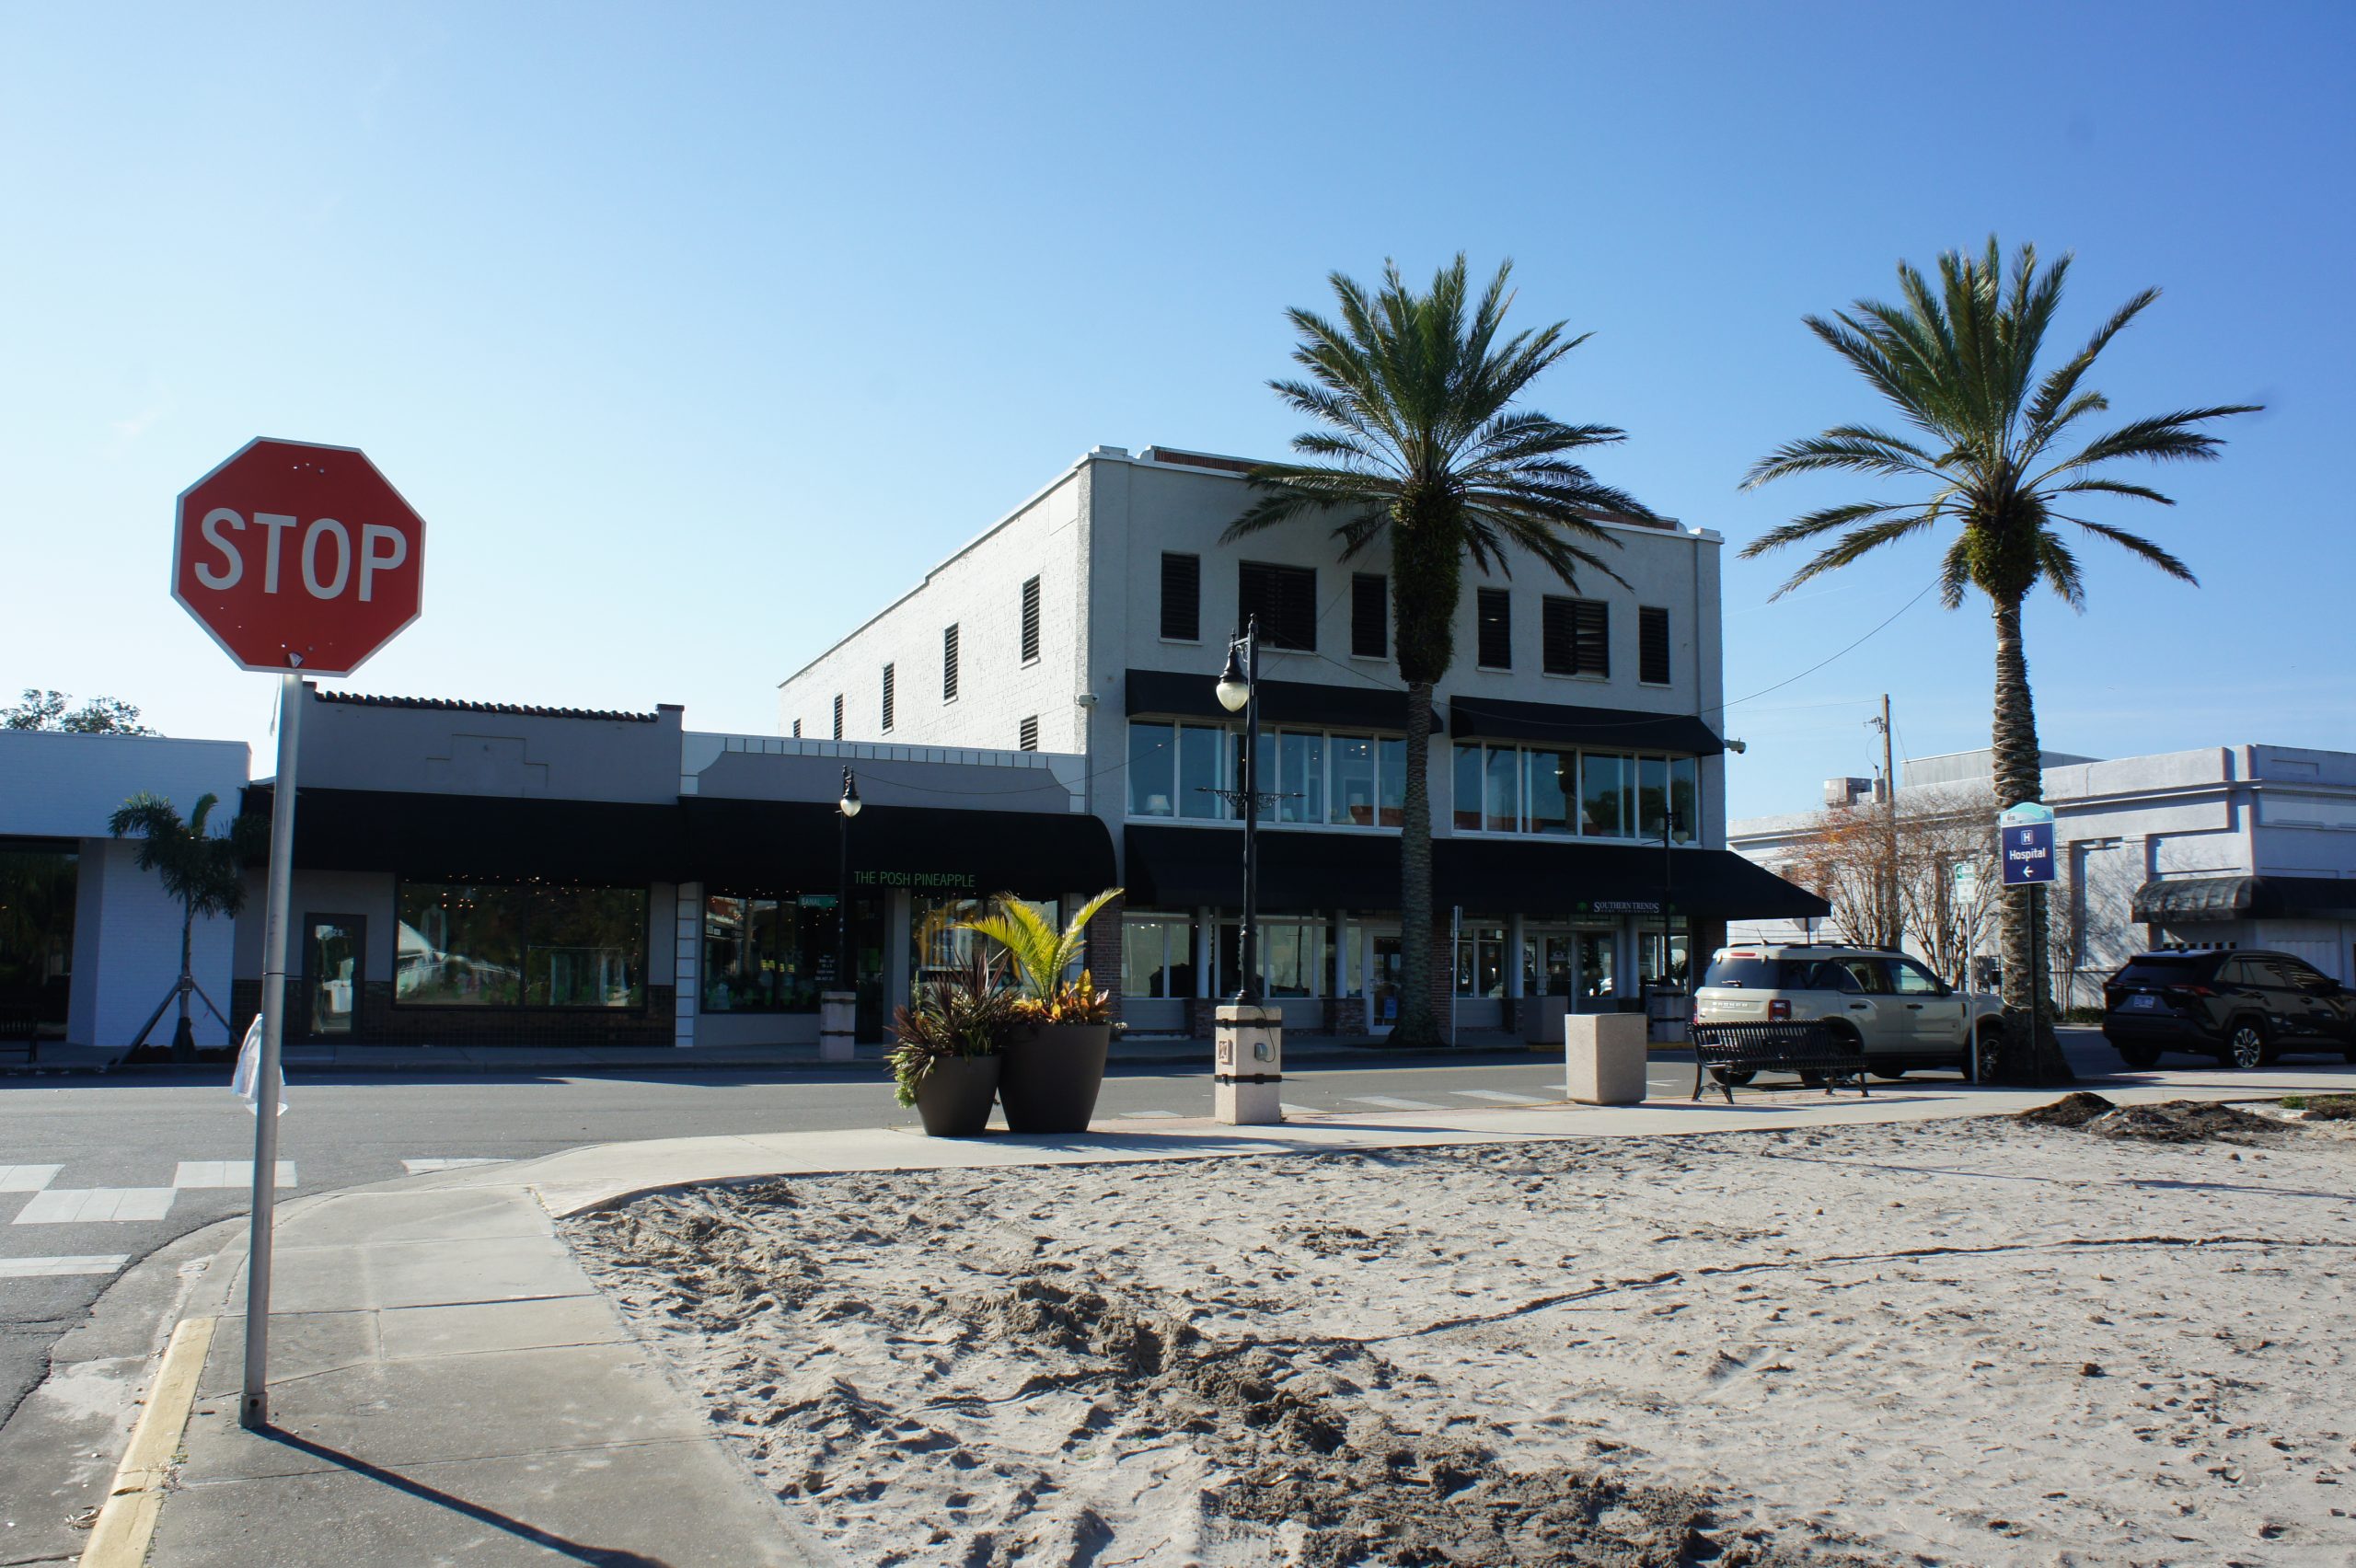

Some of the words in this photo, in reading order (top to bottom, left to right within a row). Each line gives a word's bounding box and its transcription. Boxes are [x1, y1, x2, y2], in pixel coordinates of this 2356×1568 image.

[195, 508, 407, 602] STOP
[2024, 833, 2030, 842] H
[2010, 847, 2046, 861] Hospital
[854, 870, 876, 884] THE
[880, 871, 910, 886] POSH
[914, 872, 976, 888] PINEAPPLE
[1633, 902, 1660, 914] TRENDS
